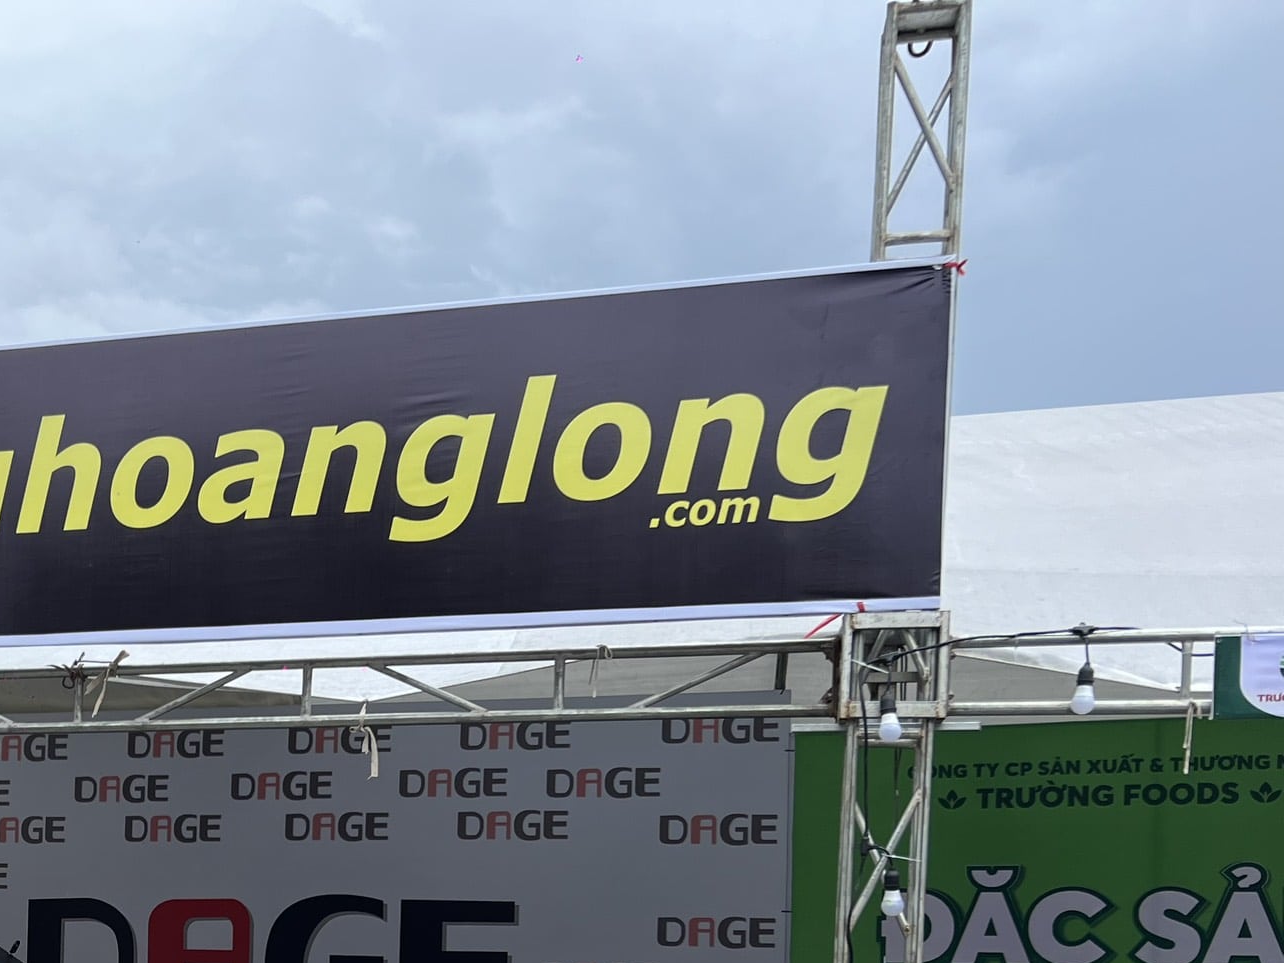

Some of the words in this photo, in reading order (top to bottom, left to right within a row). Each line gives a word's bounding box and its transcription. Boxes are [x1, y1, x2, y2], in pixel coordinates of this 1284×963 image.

[648, 490, 762, 530] .com
[1257, 692, 1284, 702] TRƯ
[127, 730, 225, 758] DAGE
[287, 727, 392, 755] DAGE
[459, 720, 571, 751] DAGE
[661, 717, 780, 745] DAGE
[973, 763, 998, 778] TY
[1004, 762, 1032, 776] CP
[1038, 757, 1081, 775] SẢN
[1087, 752, 1145, 774] XUẤT
[1149, 757, 1164, 772] &
[1169, 754, 1272, 772] THƯƠNG
[74, 775, 170, 803] DAGE
[230, 771, 333, 801] DAGE
[399, 767, 509, 799] DAGE
[546, 767, 661, 799] DAGE
[976, 781, 1115, 810] TRƯỜNG
[1123, 781, 1240, 807] FOODS
[124, 814, 222, 843] DAGE
[285, 812, 390, 842] DAGE
[457, 810, 569, 841] DAGE
[659, 813, 778, 846] DAGE
[656, 916, 777, 949] DAGE
